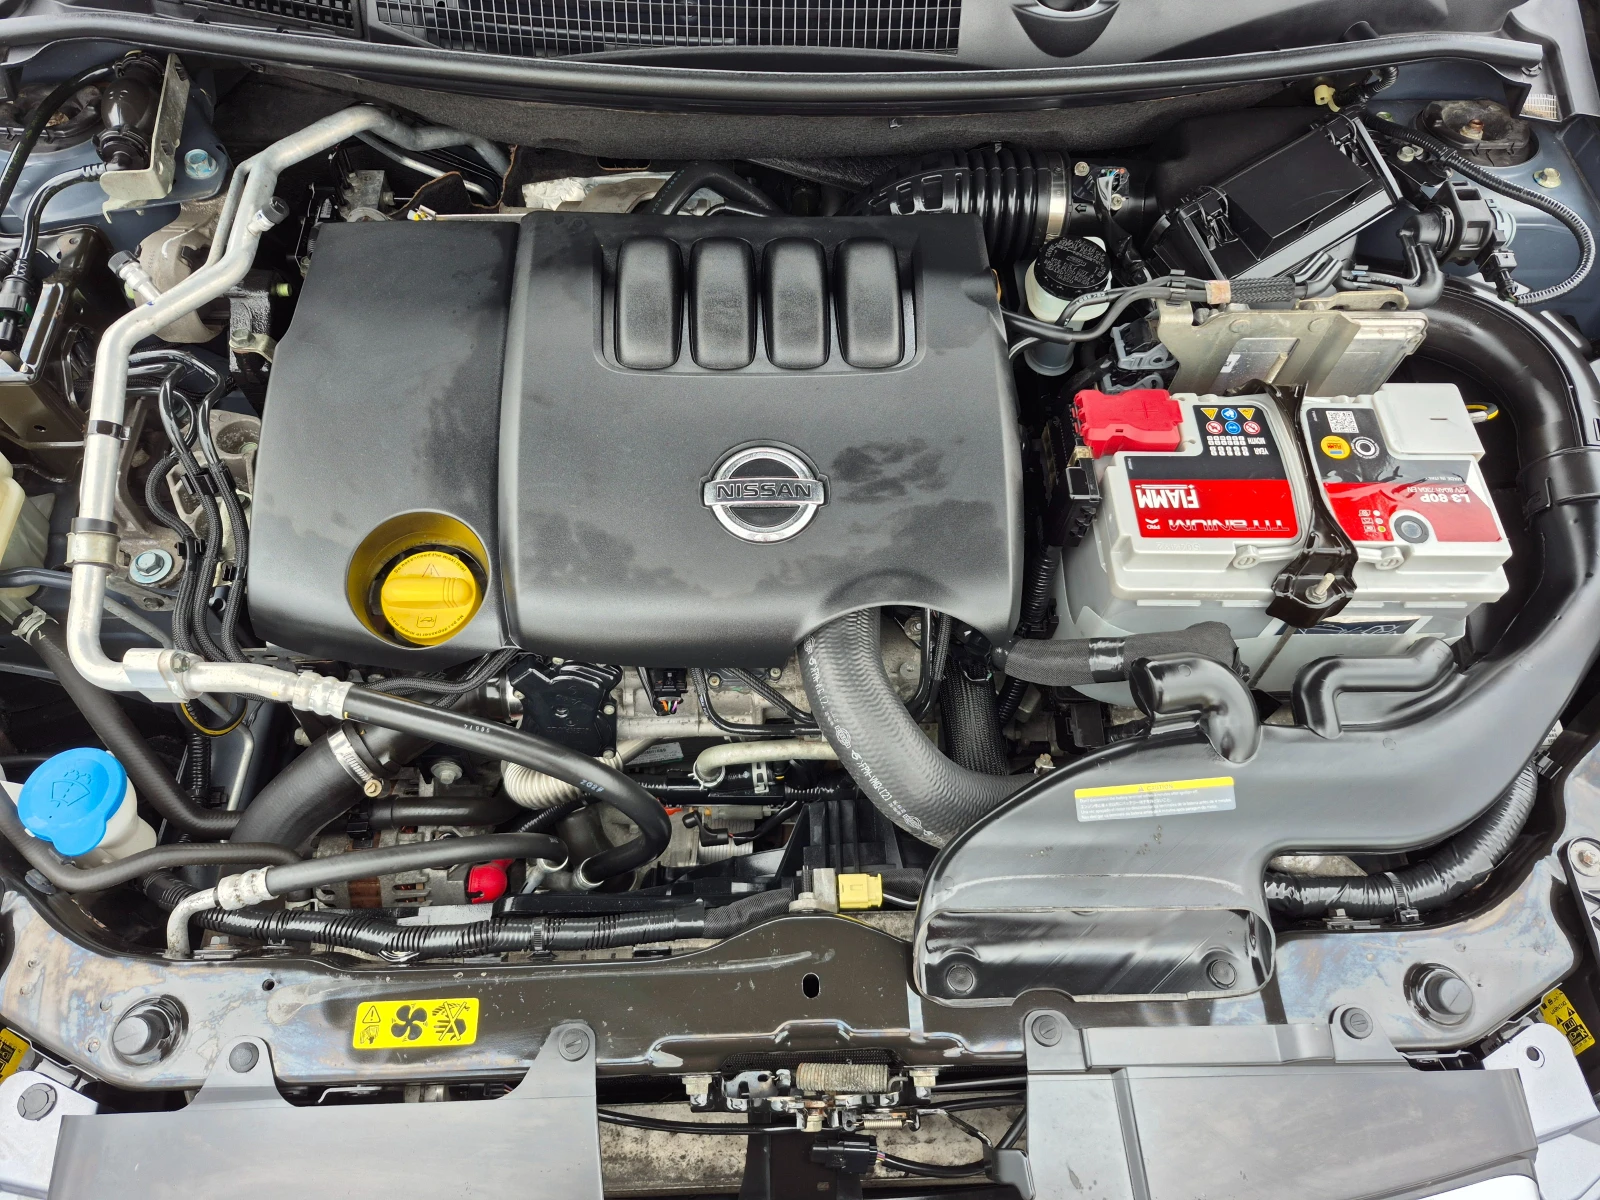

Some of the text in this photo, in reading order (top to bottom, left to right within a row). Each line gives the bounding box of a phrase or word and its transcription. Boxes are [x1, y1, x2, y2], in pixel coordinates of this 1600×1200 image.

[1253, 447, 1269, 455] YEAR
[716, 483, 812, 499] NISSAN
[1135, 488, 1200, 509] FIAMM
[1419, 493, 1471, 503] L3 80P
